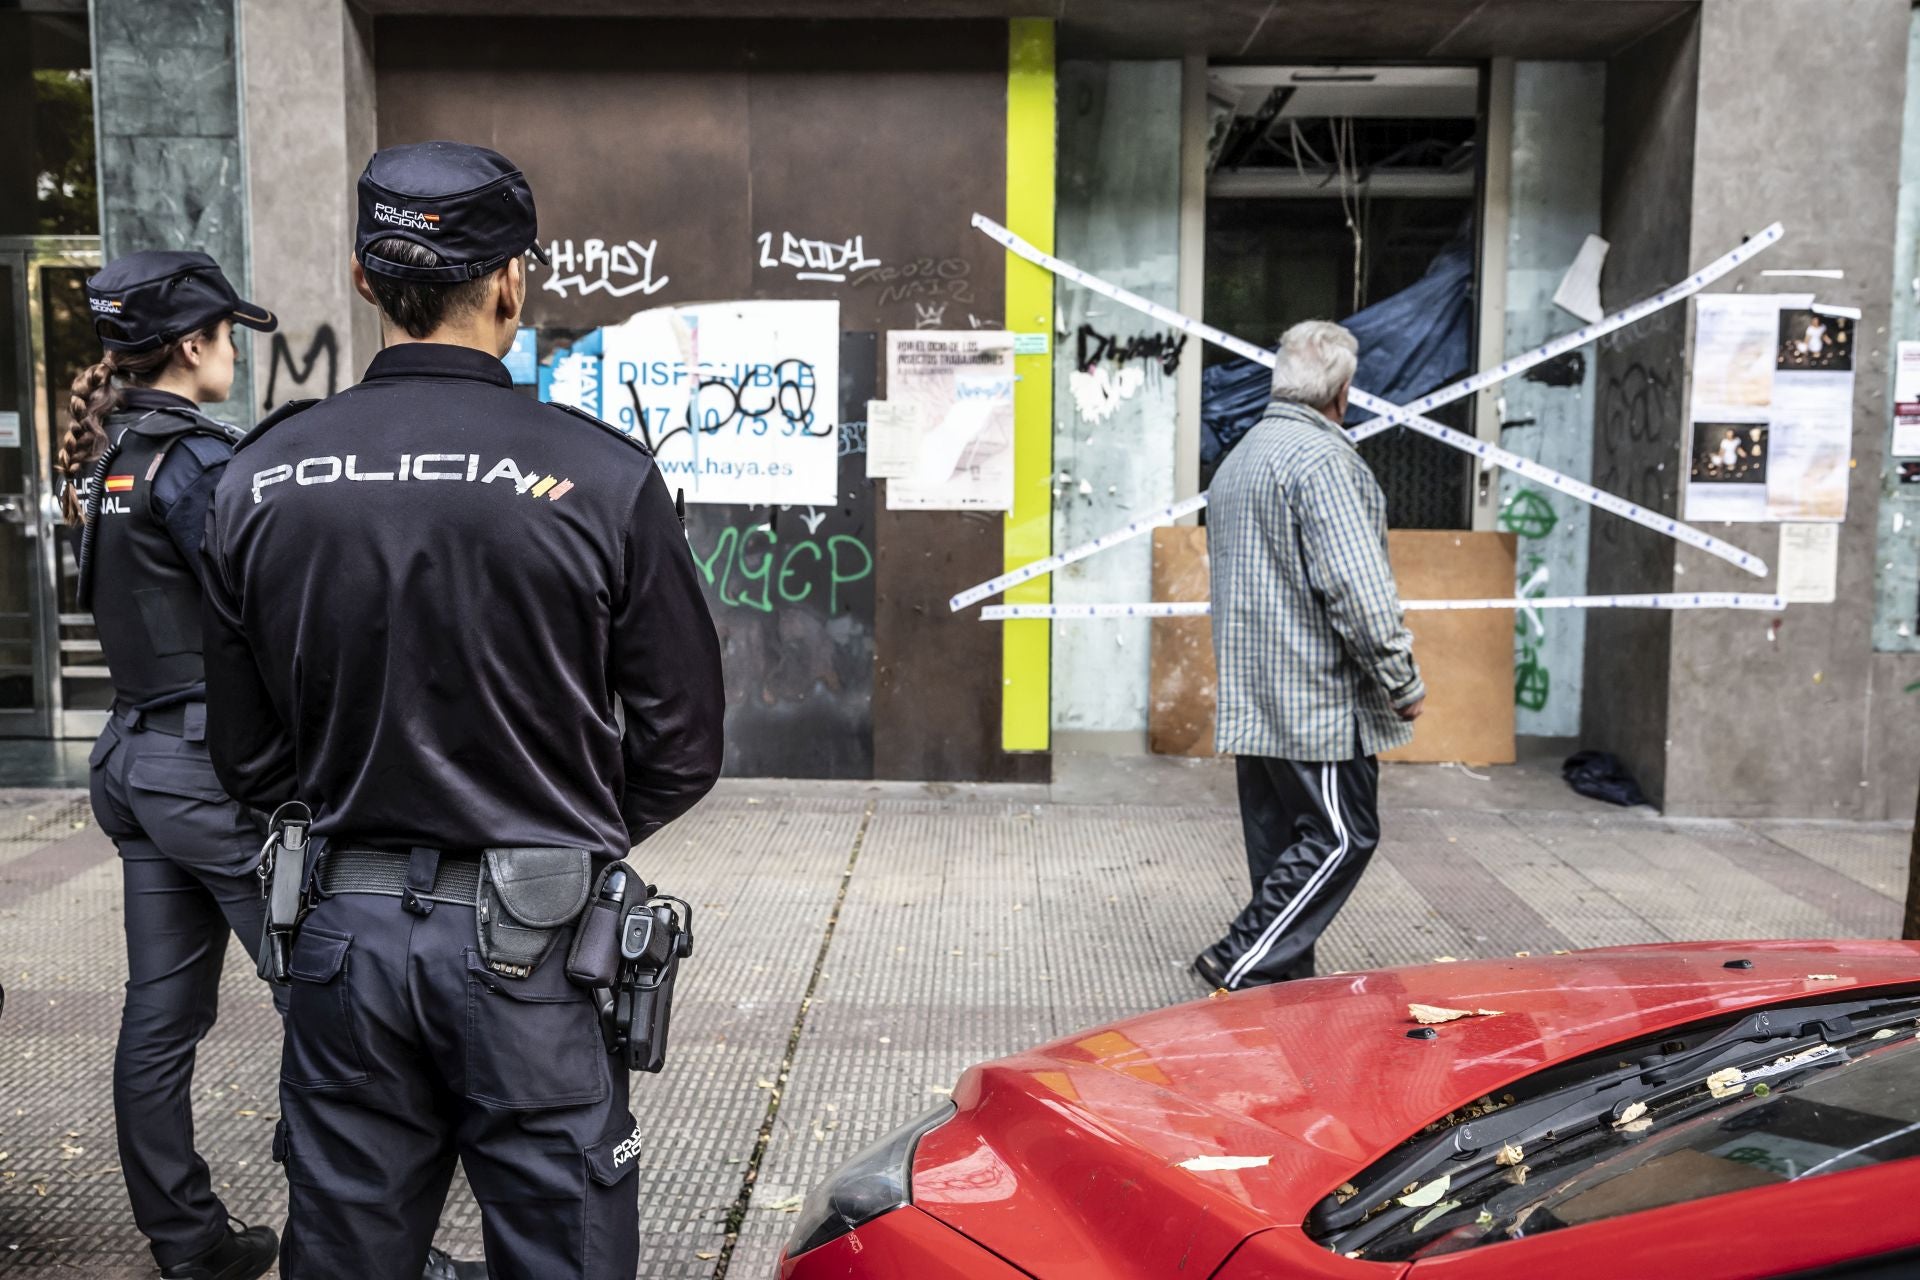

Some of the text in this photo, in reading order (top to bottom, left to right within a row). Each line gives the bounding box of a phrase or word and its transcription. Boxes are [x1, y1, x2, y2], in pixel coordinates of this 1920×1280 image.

[374, 211, 440, 231] NACIONAL
[263, 323, 338, 411] M
[252, 453, 526, 504] POLICIA
[656, 457, 794, 480] ww.haya.es
